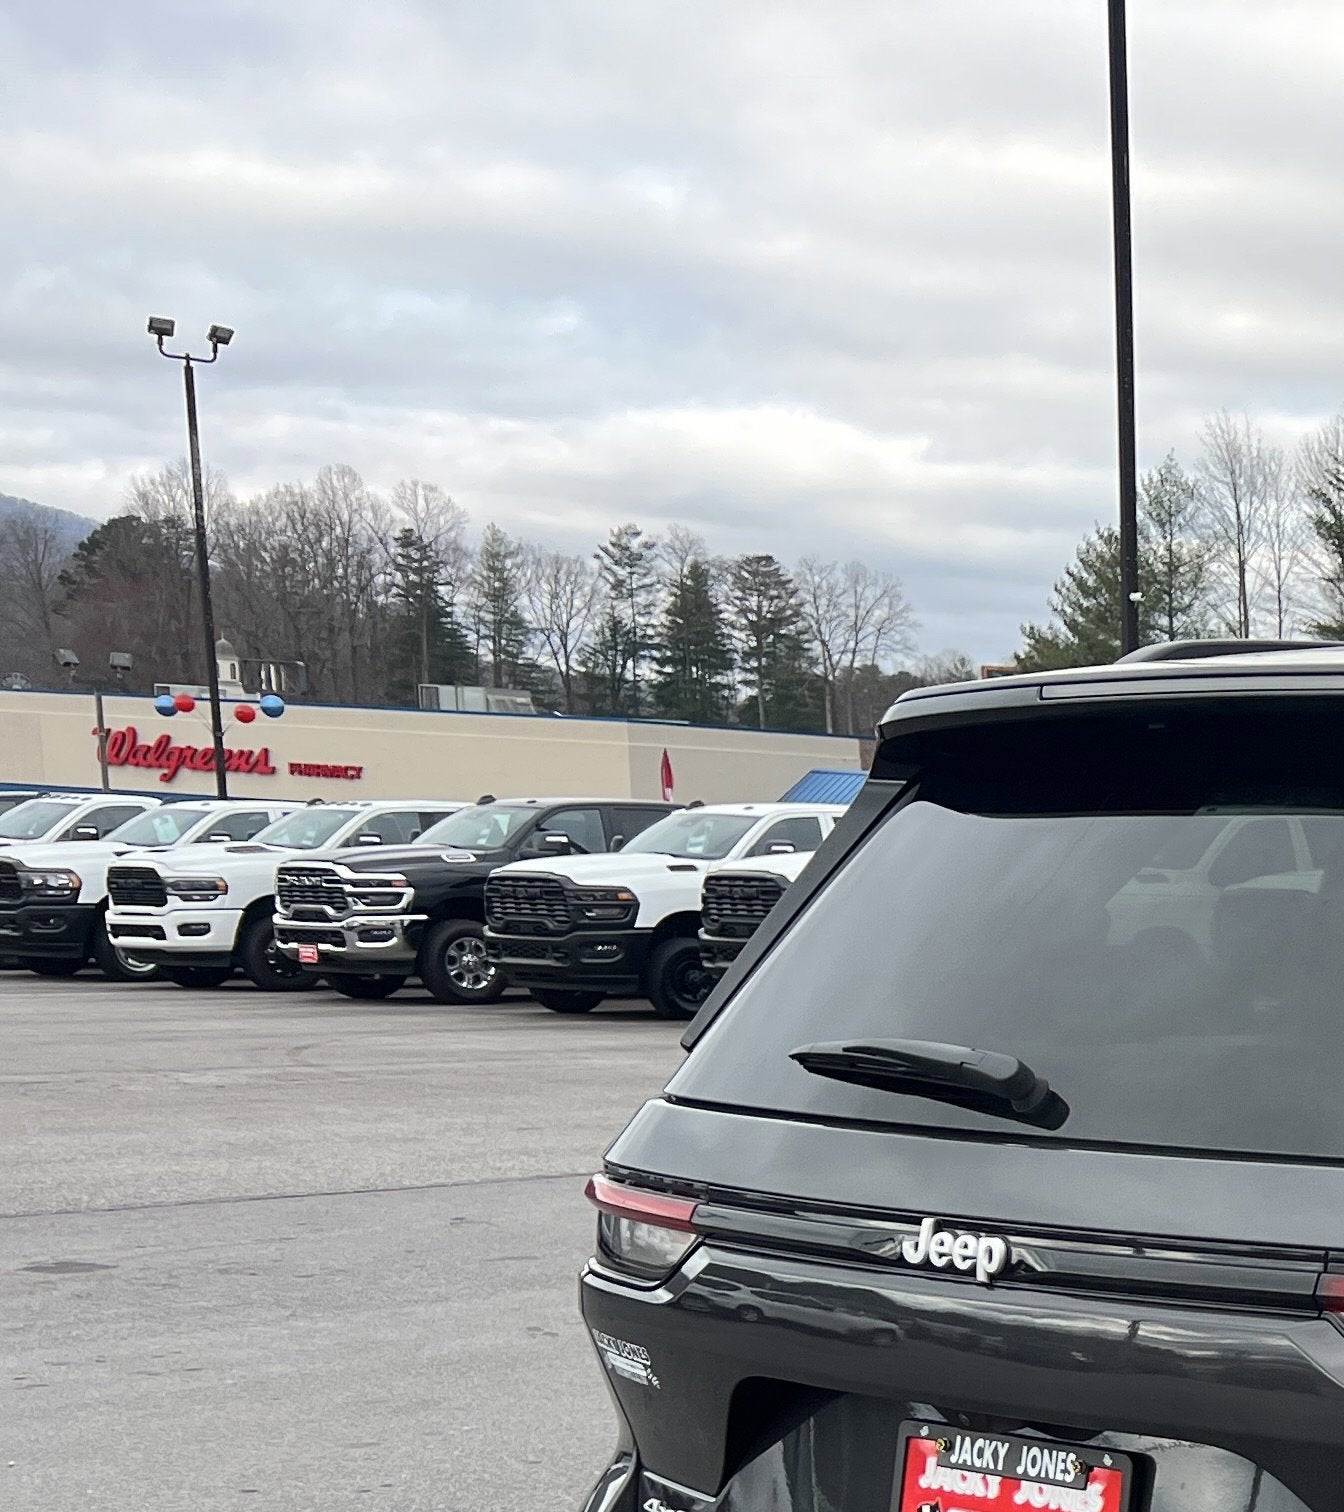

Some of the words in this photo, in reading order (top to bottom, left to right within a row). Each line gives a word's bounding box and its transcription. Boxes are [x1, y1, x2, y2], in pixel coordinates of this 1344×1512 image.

[92, 727, 276, 783] Walgreens
[902, 1217, 1008, 1283] Jeep
[919, 1457, 1001, 1498] JACKY
[950, 1435, 1010, 1471] JACKY
[1016, 1445, 1077, 1483] JONES
